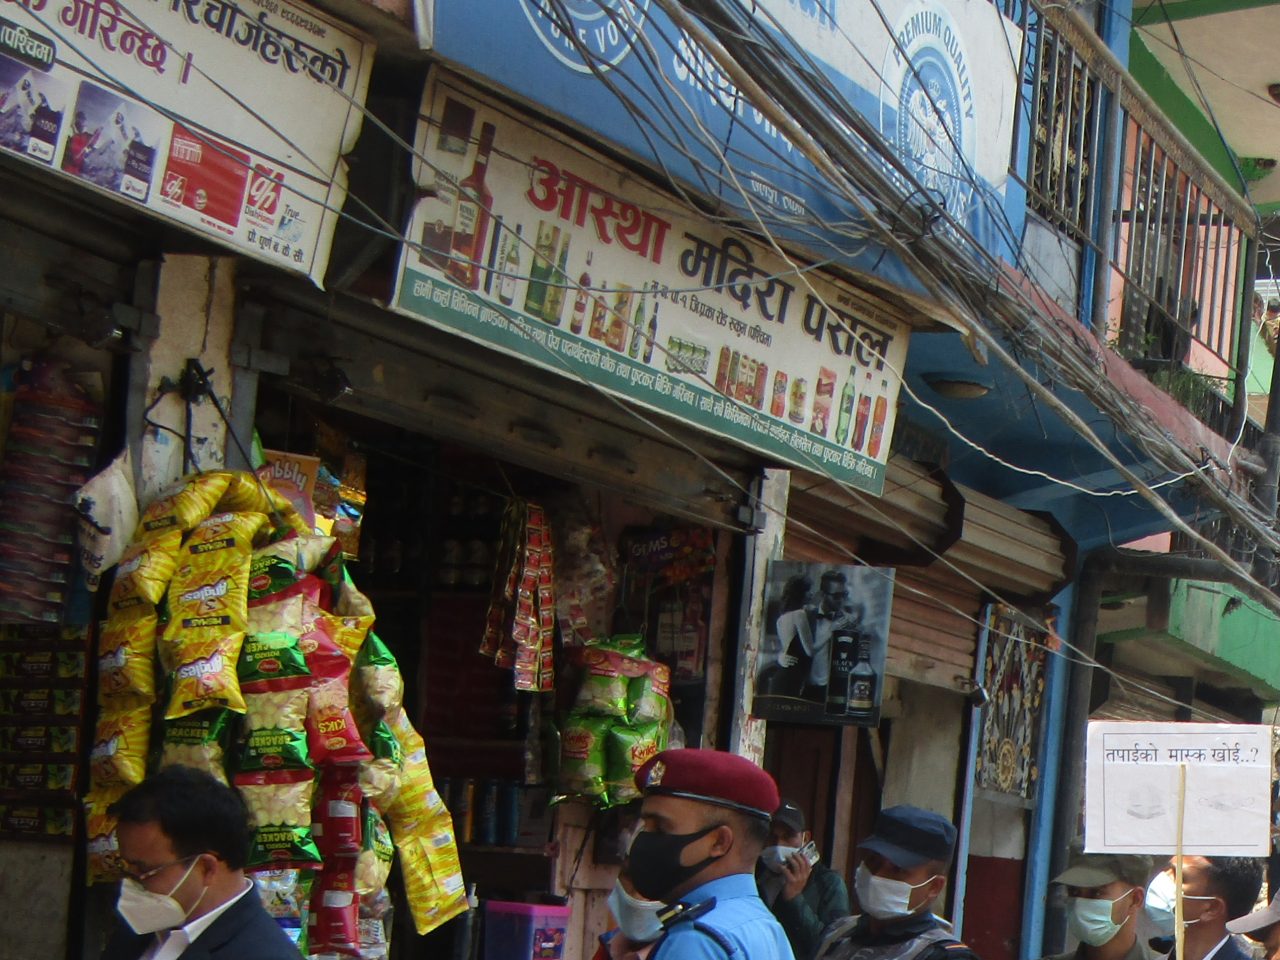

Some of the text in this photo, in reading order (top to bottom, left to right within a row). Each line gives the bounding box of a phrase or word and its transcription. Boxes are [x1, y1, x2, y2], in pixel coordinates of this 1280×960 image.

[893, 11, 943, 67] PREMIUM
[943, 26, 974, 120] QUALITY
[524, 155, 672, 264] आस्था
[678, 231, 795, 324] मदिरा
[802, 293, 894, 372] पसल
[179, 650, 224, 679] Angles
[318, 719, 346, 734] KIKS
[1168, 748, 1207, 762] मास्क
